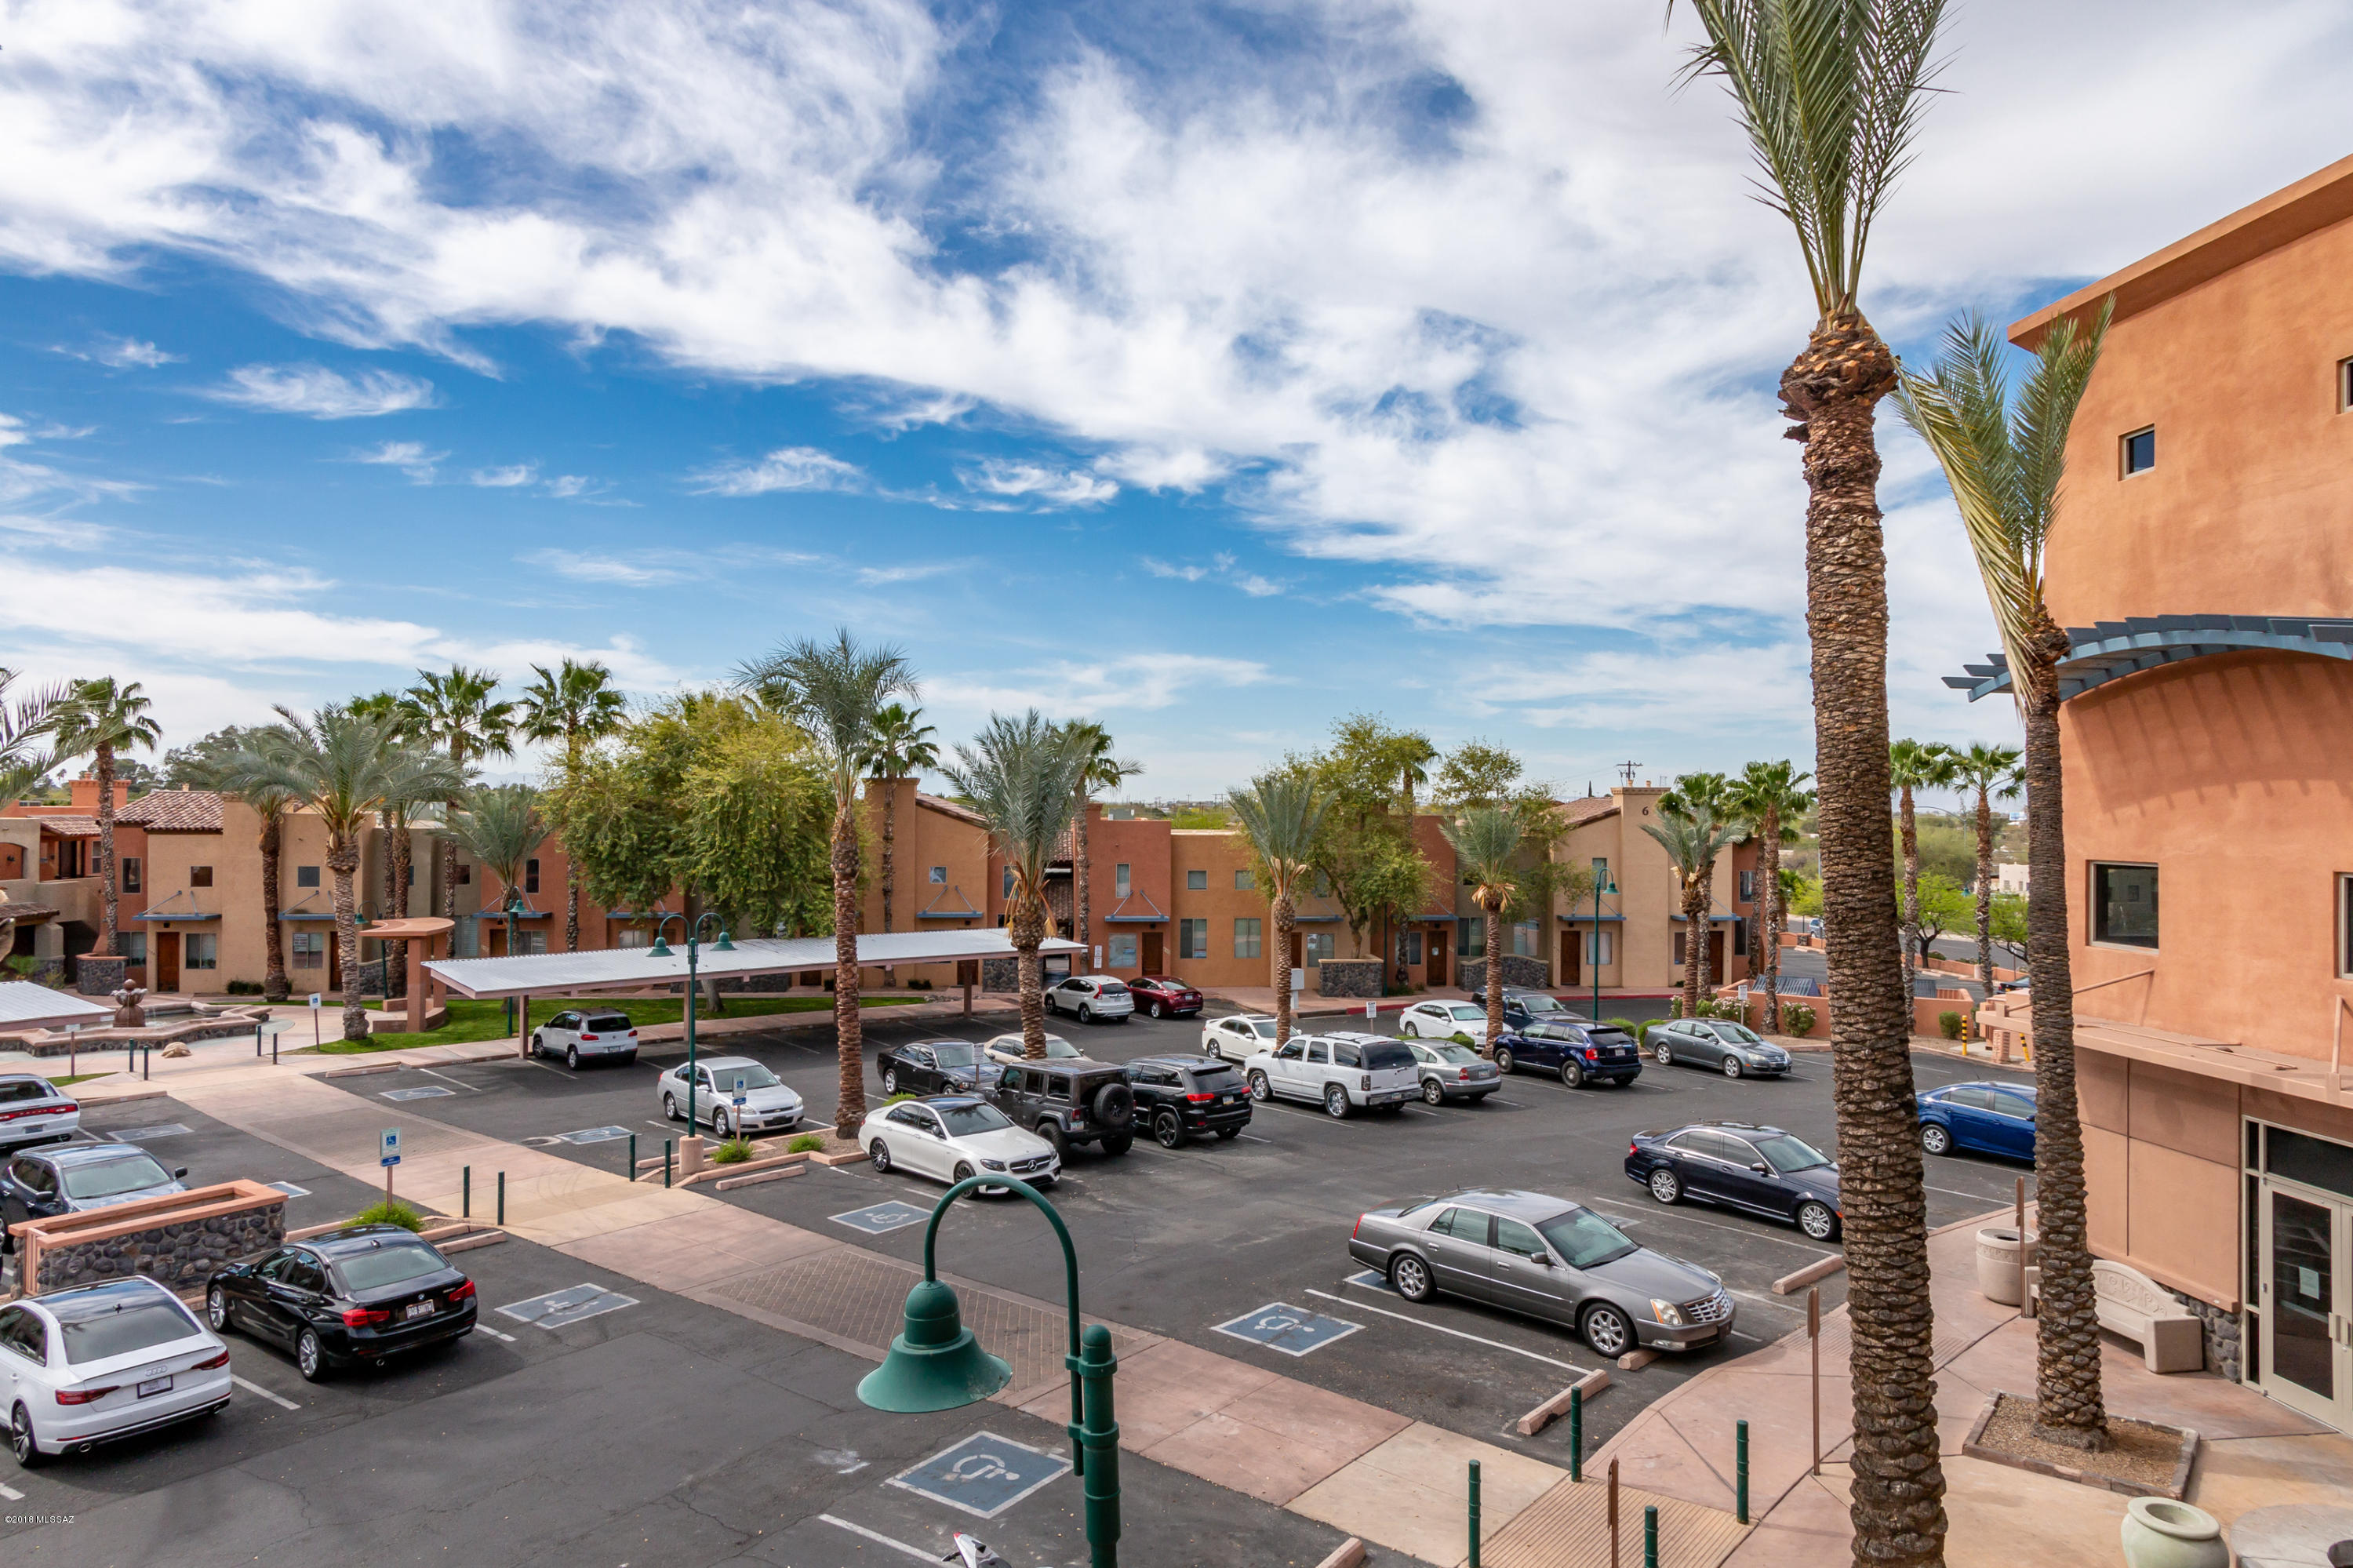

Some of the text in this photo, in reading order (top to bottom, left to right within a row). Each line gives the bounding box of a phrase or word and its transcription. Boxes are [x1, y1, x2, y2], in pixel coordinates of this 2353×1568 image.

[1642, 806, 1649, 816] 6
[408, 1302, 431, 1316] BOB SMITH
